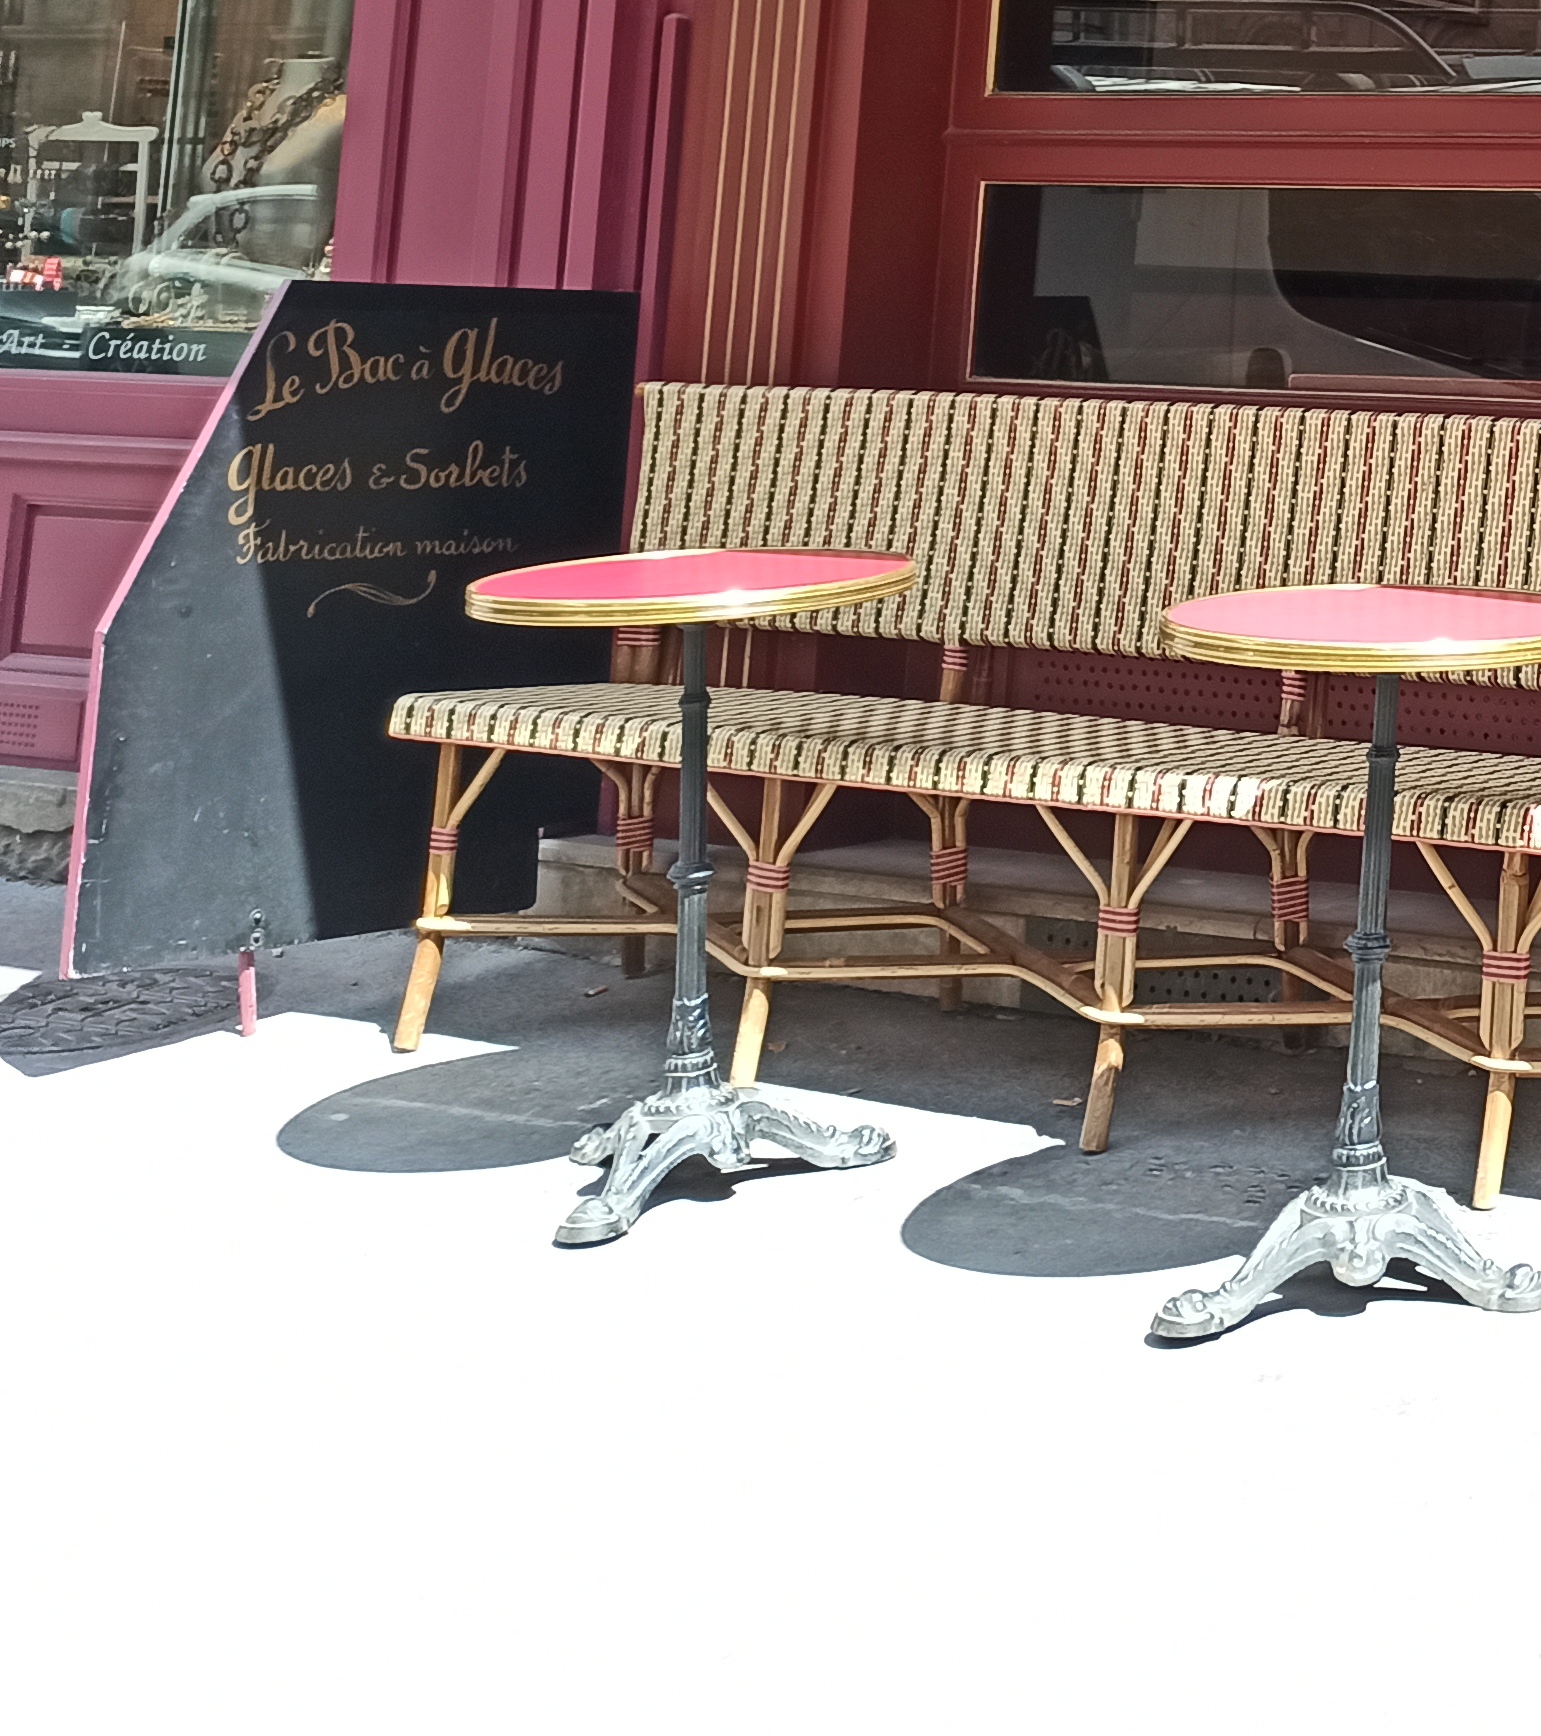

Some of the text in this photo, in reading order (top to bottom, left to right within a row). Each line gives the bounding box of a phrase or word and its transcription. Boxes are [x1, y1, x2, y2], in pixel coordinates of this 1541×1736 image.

[0, 329, 207, 362] Art Création
[245, 330, 305, 421] Le
[306, 318, 406, 394] Bac
[410, 346, 435, 380] à
[368, 462, 394, 489] &
[399, 440, 529, 491] Sorbets
[235, 518, 521, 566] Fabrication maison
